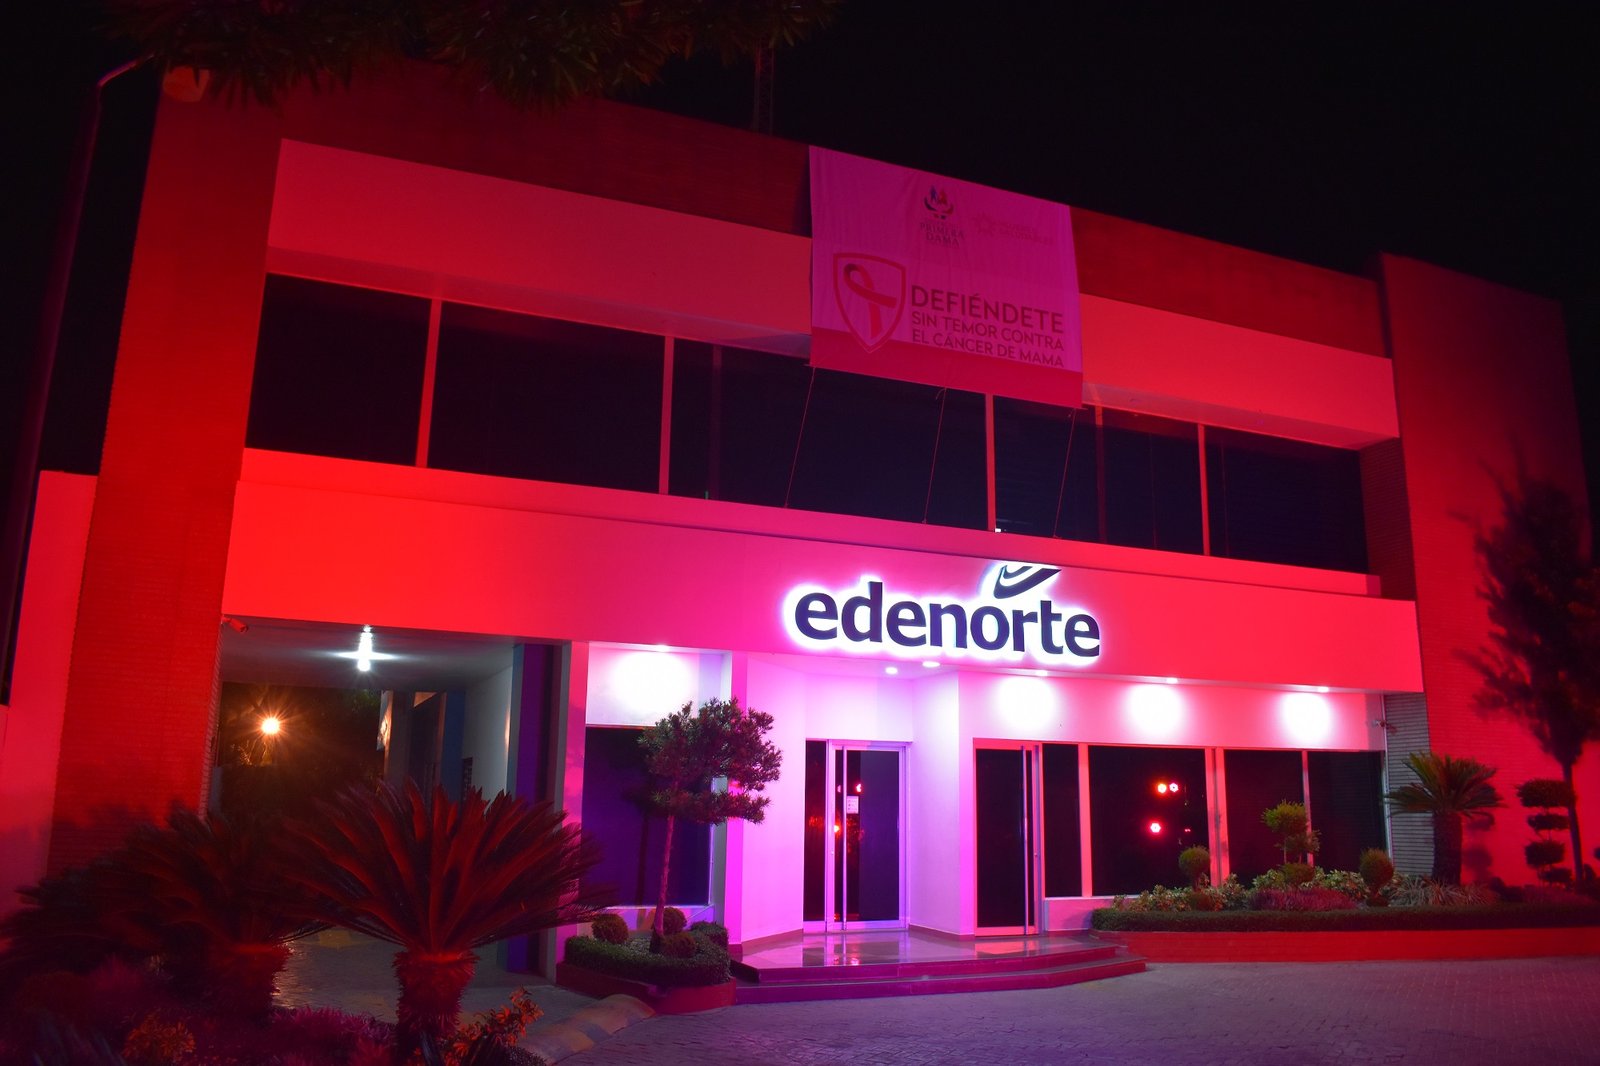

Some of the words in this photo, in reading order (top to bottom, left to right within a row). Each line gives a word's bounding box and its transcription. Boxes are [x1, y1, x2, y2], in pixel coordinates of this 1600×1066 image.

[920, 222, 965, 240] PRIMERA
[926, 232, 960, 247] DAMA
[912, 285, 1063, 334] DEFIÉNDETE
[912, 310, 937, 328] SIN
[943, 316, 997, 338] TEMOR
[1001, 328, 1065, 351] CONTRA
[912, 328, 930, 345] EL
[933, 332, 993, 354] CÁNCER
[998, 344, 1016, 359] DE
[1020, 349, 1064, 367] MAMA
[795, 580, 1100, 656] edenorte
